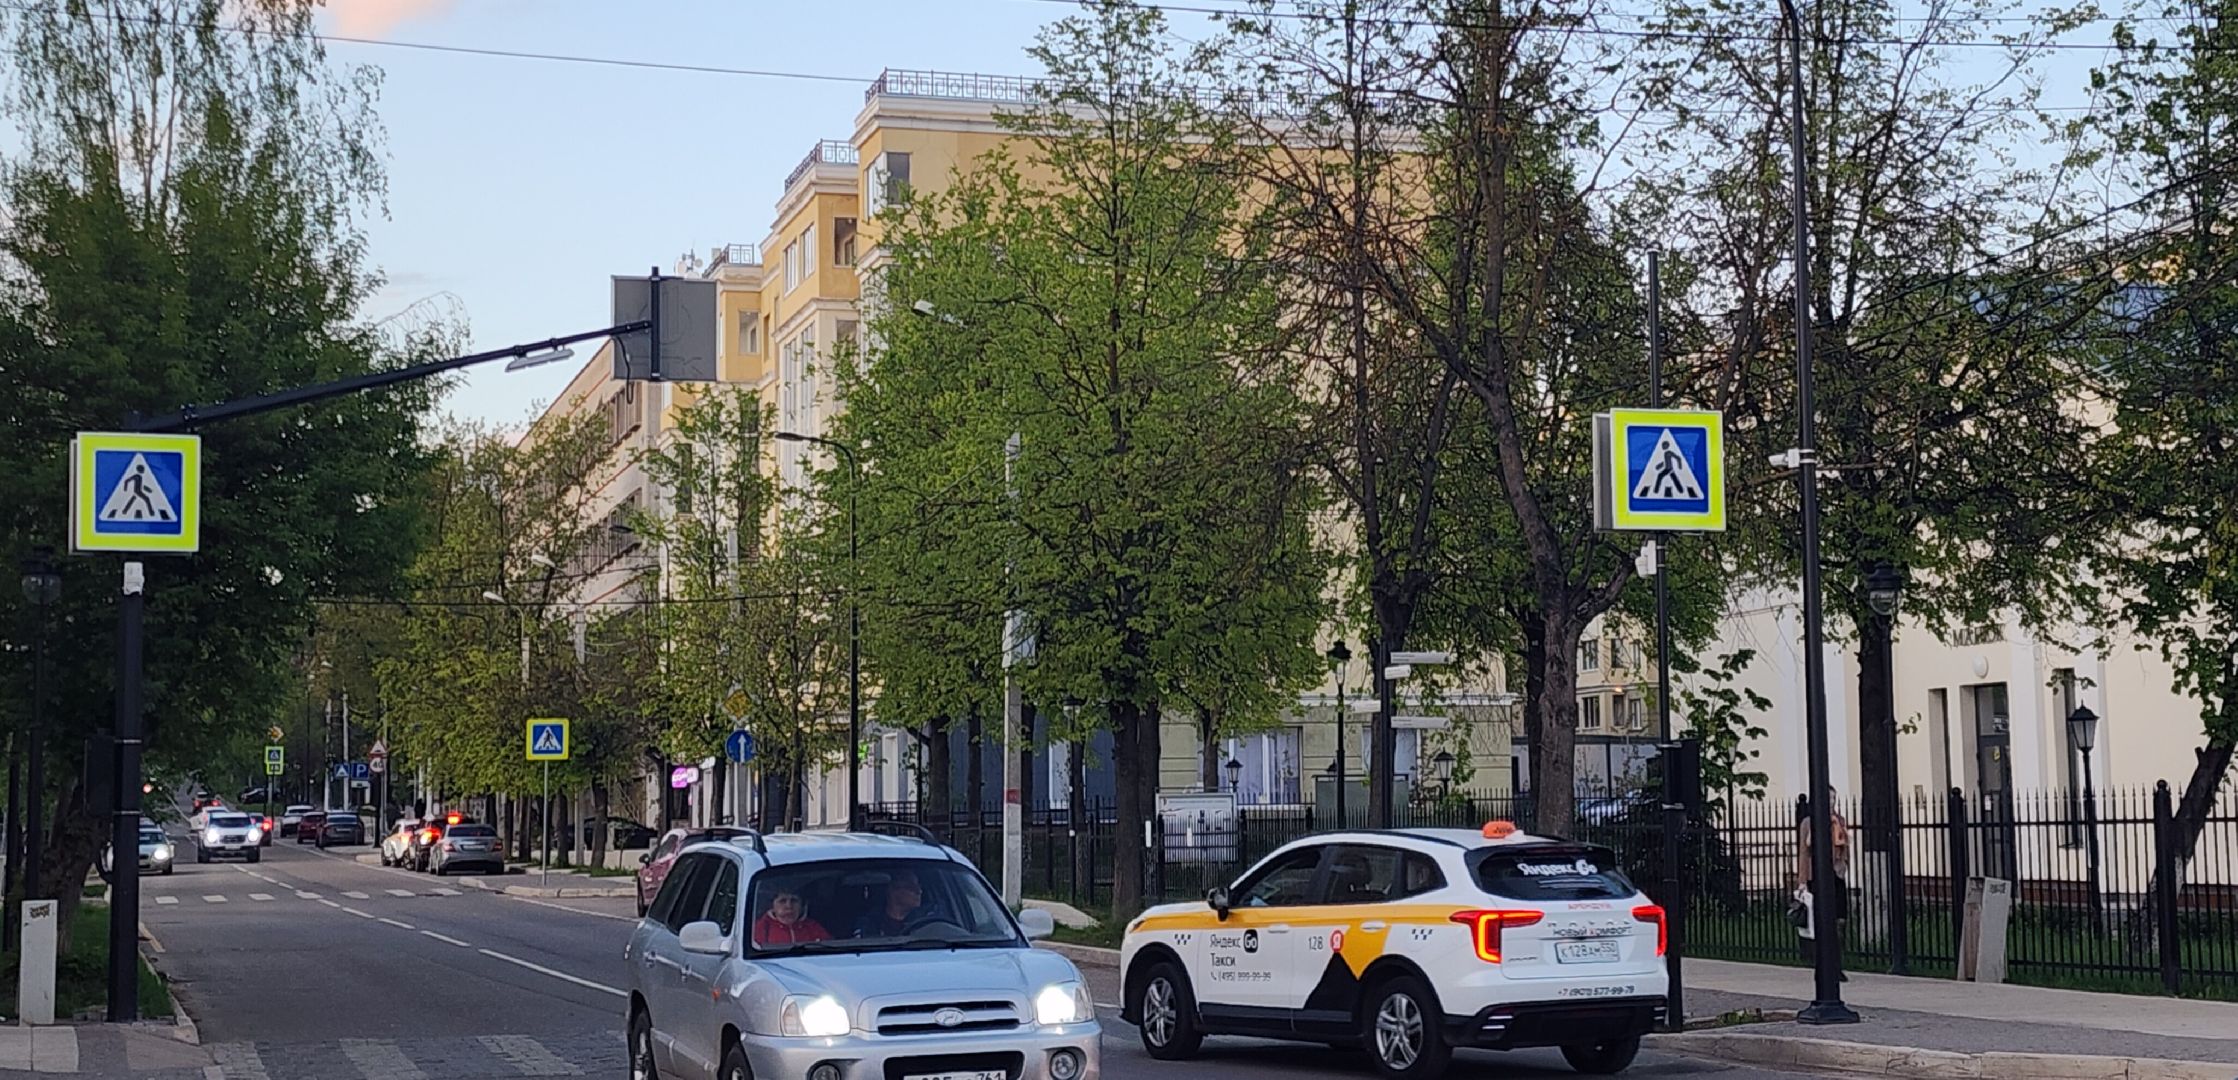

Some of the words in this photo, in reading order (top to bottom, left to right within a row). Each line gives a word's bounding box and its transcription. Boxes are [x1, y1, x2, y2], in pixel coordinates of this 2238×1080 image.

[357, 764, 367, 777] P
[1517, 863, 1577, 875] Яндекс
[1576, 859, 1598, 875] Go
[1553, 927, 1587, 937] НОВЫЙ
[1210, 934, 1240, 949] Яндекс
[1244, 932, 1257, 949] Go
[1308, 936, 1323, 950] 128
[1210, 953, 1235, 967] Такси
